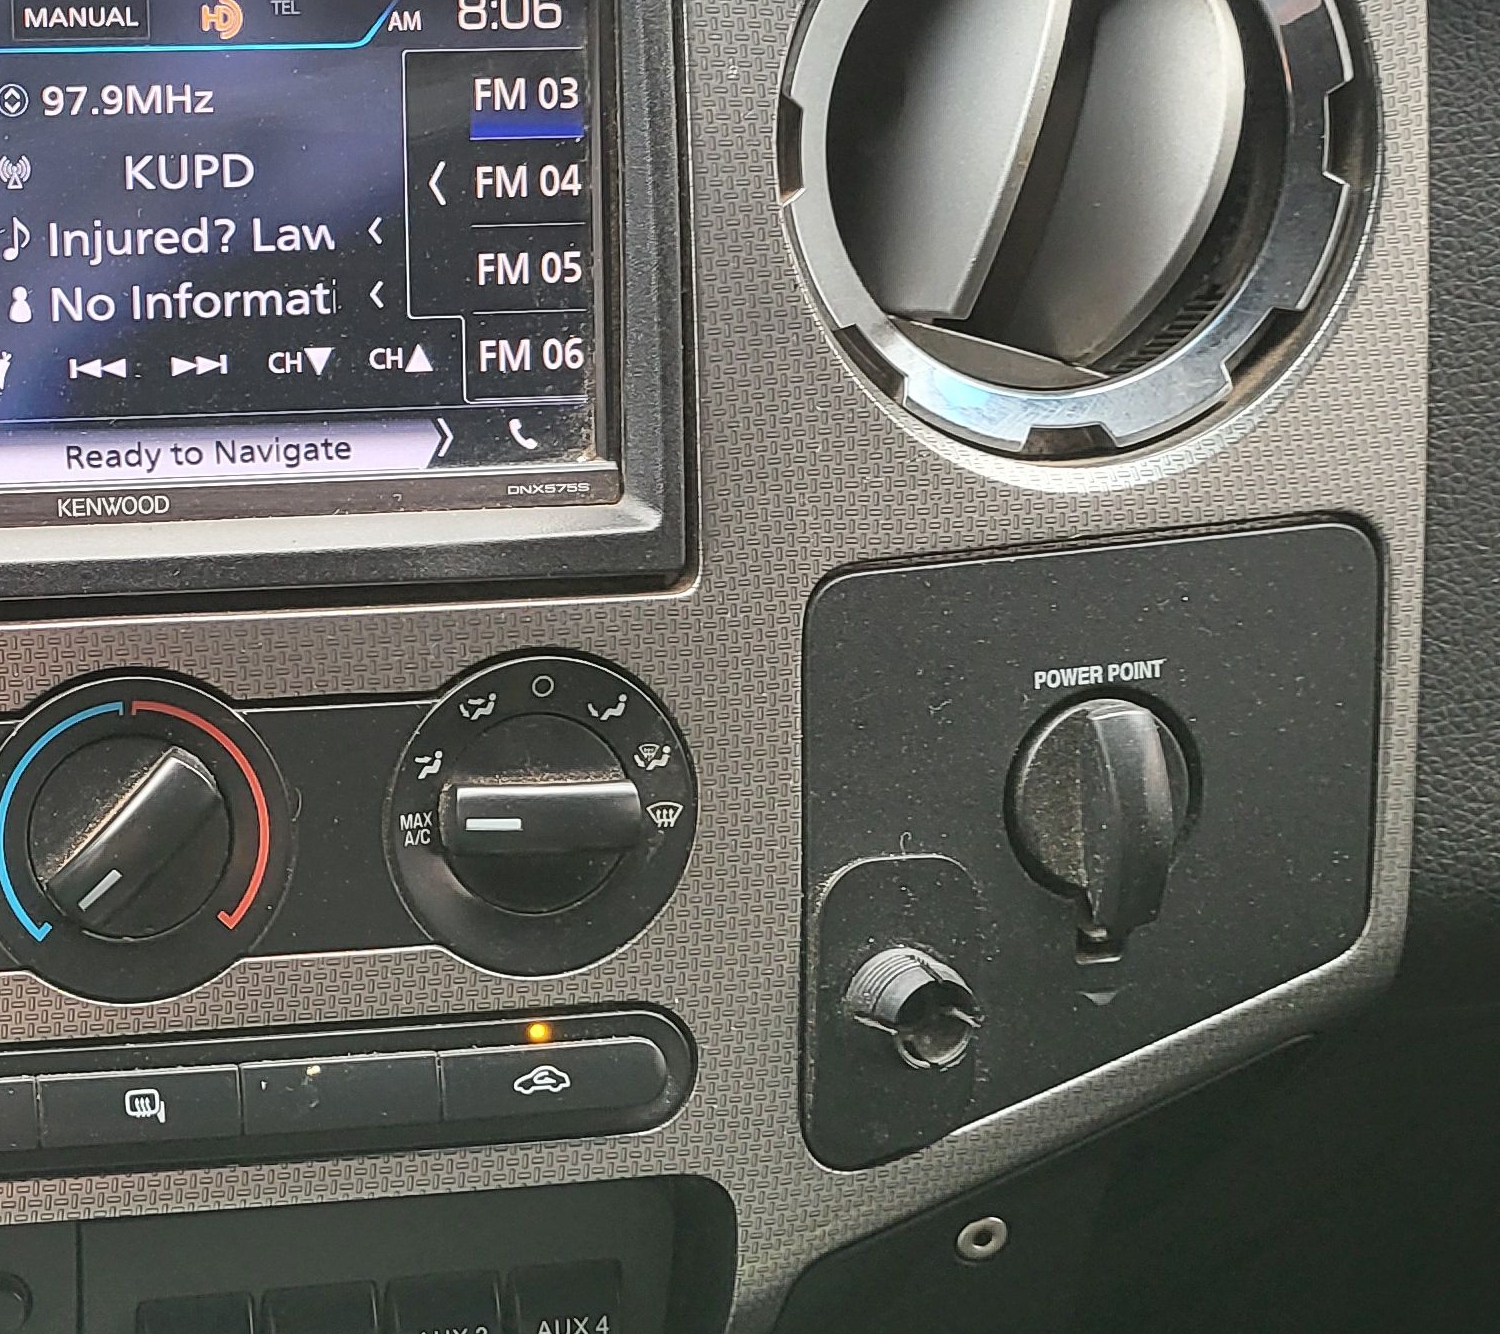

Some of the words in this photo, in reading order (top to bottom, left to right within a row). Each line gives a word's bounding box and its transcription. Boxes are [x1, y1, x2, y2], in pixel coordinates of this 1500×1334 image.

[22, 5, 139, 29] MANUAL
[387, 8, 423, 33] AM
[40, 83, 214, 117] 97.9MHz
[472, 77, 526, 109] FM
[536, 76, 579, 107] 03
[123, 152, 254, 189] KUPD
[474, 164, 527, 196] FM
[538, 163, 581, 195] 04
[48, 216, 235, 265] Injured?
[252, 217, 334, 252] Law
[476, 252, 530, 285] FM
[540, 250, 582, 282] 05
[50, 285, 114, 321] No
[267, 352, 301, 372] CH
[368, 348, 401, 368] CH
[478, 339, 530, 371] FM
[543, 337, 585, 369] 06
[65, 444, 159, 473] Ready
[169, 441, 202, 465] to
[214, 437, 351, 468] Navigate
[507, 481, 591, 496] DNX575S
[57, 495, 171, 519] KENWOOD
[1033, 664, 1104, 690] POWER
[1107, 658, 1168, 682] POINT
[399, 812, 434, 831] MAX
[403, 828, 433, 847] A/C
